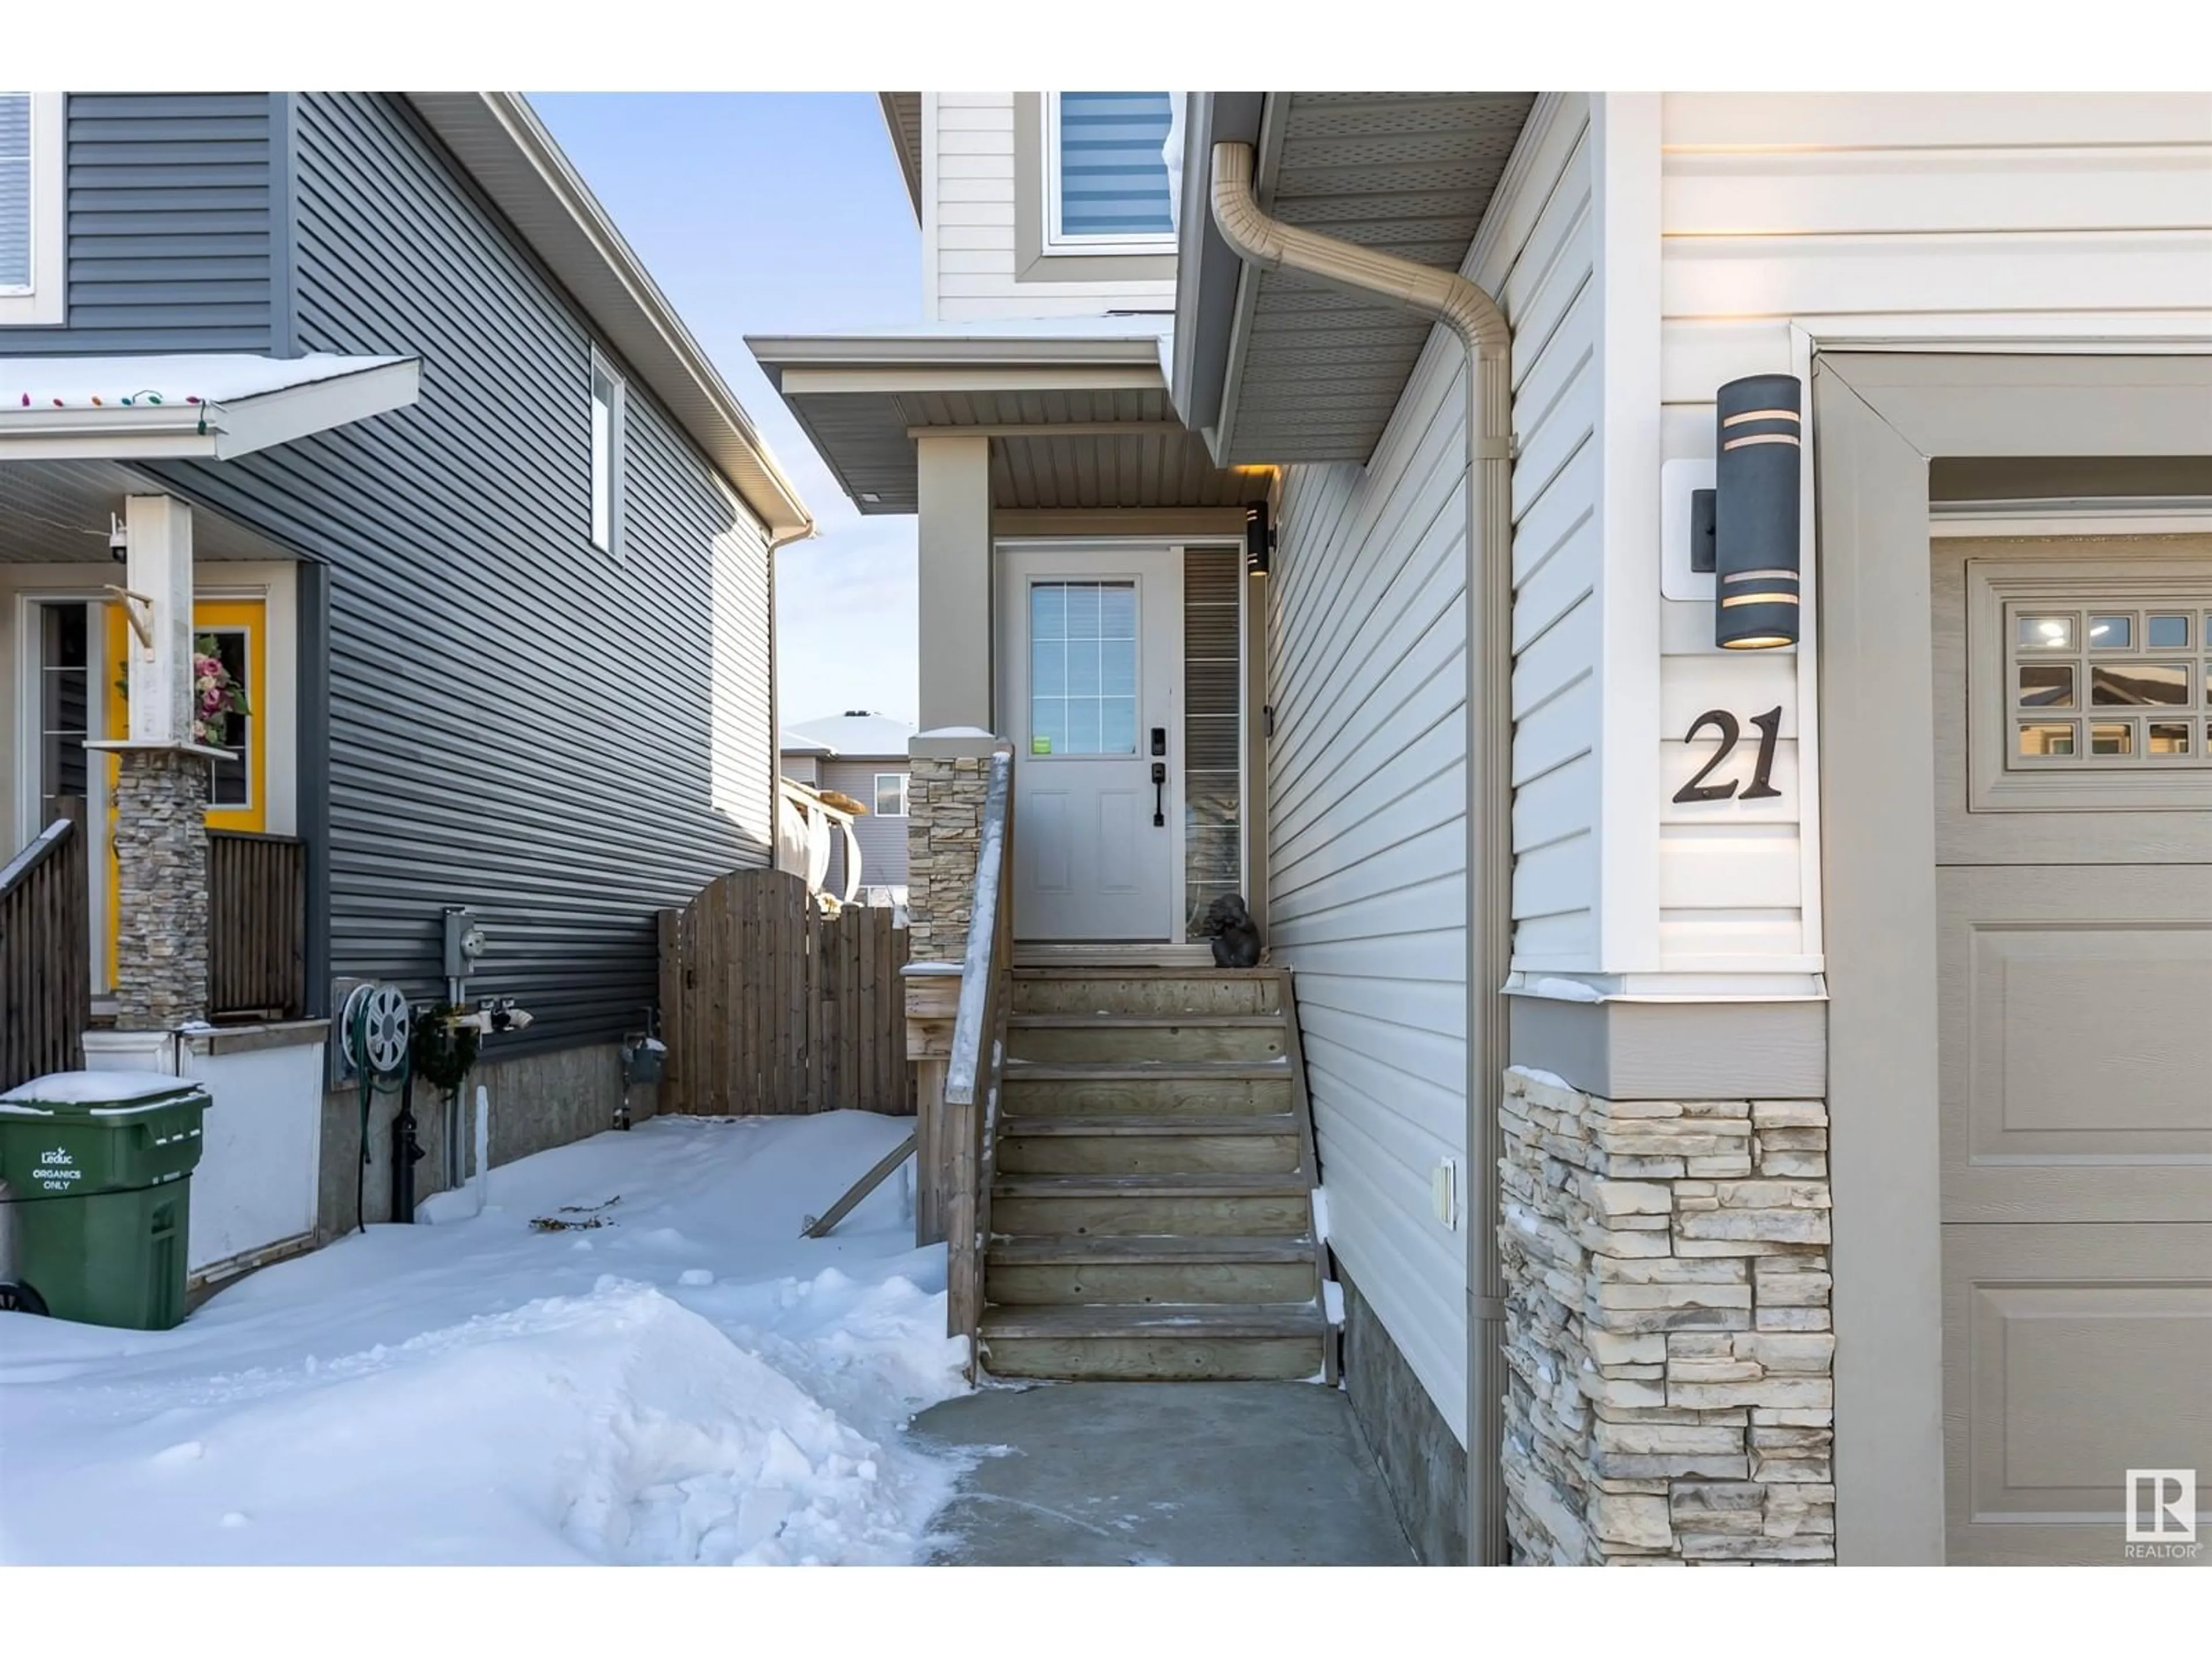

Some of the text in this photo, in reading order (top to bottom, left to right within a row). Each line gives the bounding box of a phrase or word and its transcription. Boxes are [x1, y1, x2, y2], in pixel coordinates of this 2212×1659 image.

[1673, 705, 1782, 804] 21
[33, 1169, 81, 1179] ORGANICS
[44, 1180, 70, 1190] ONLY
